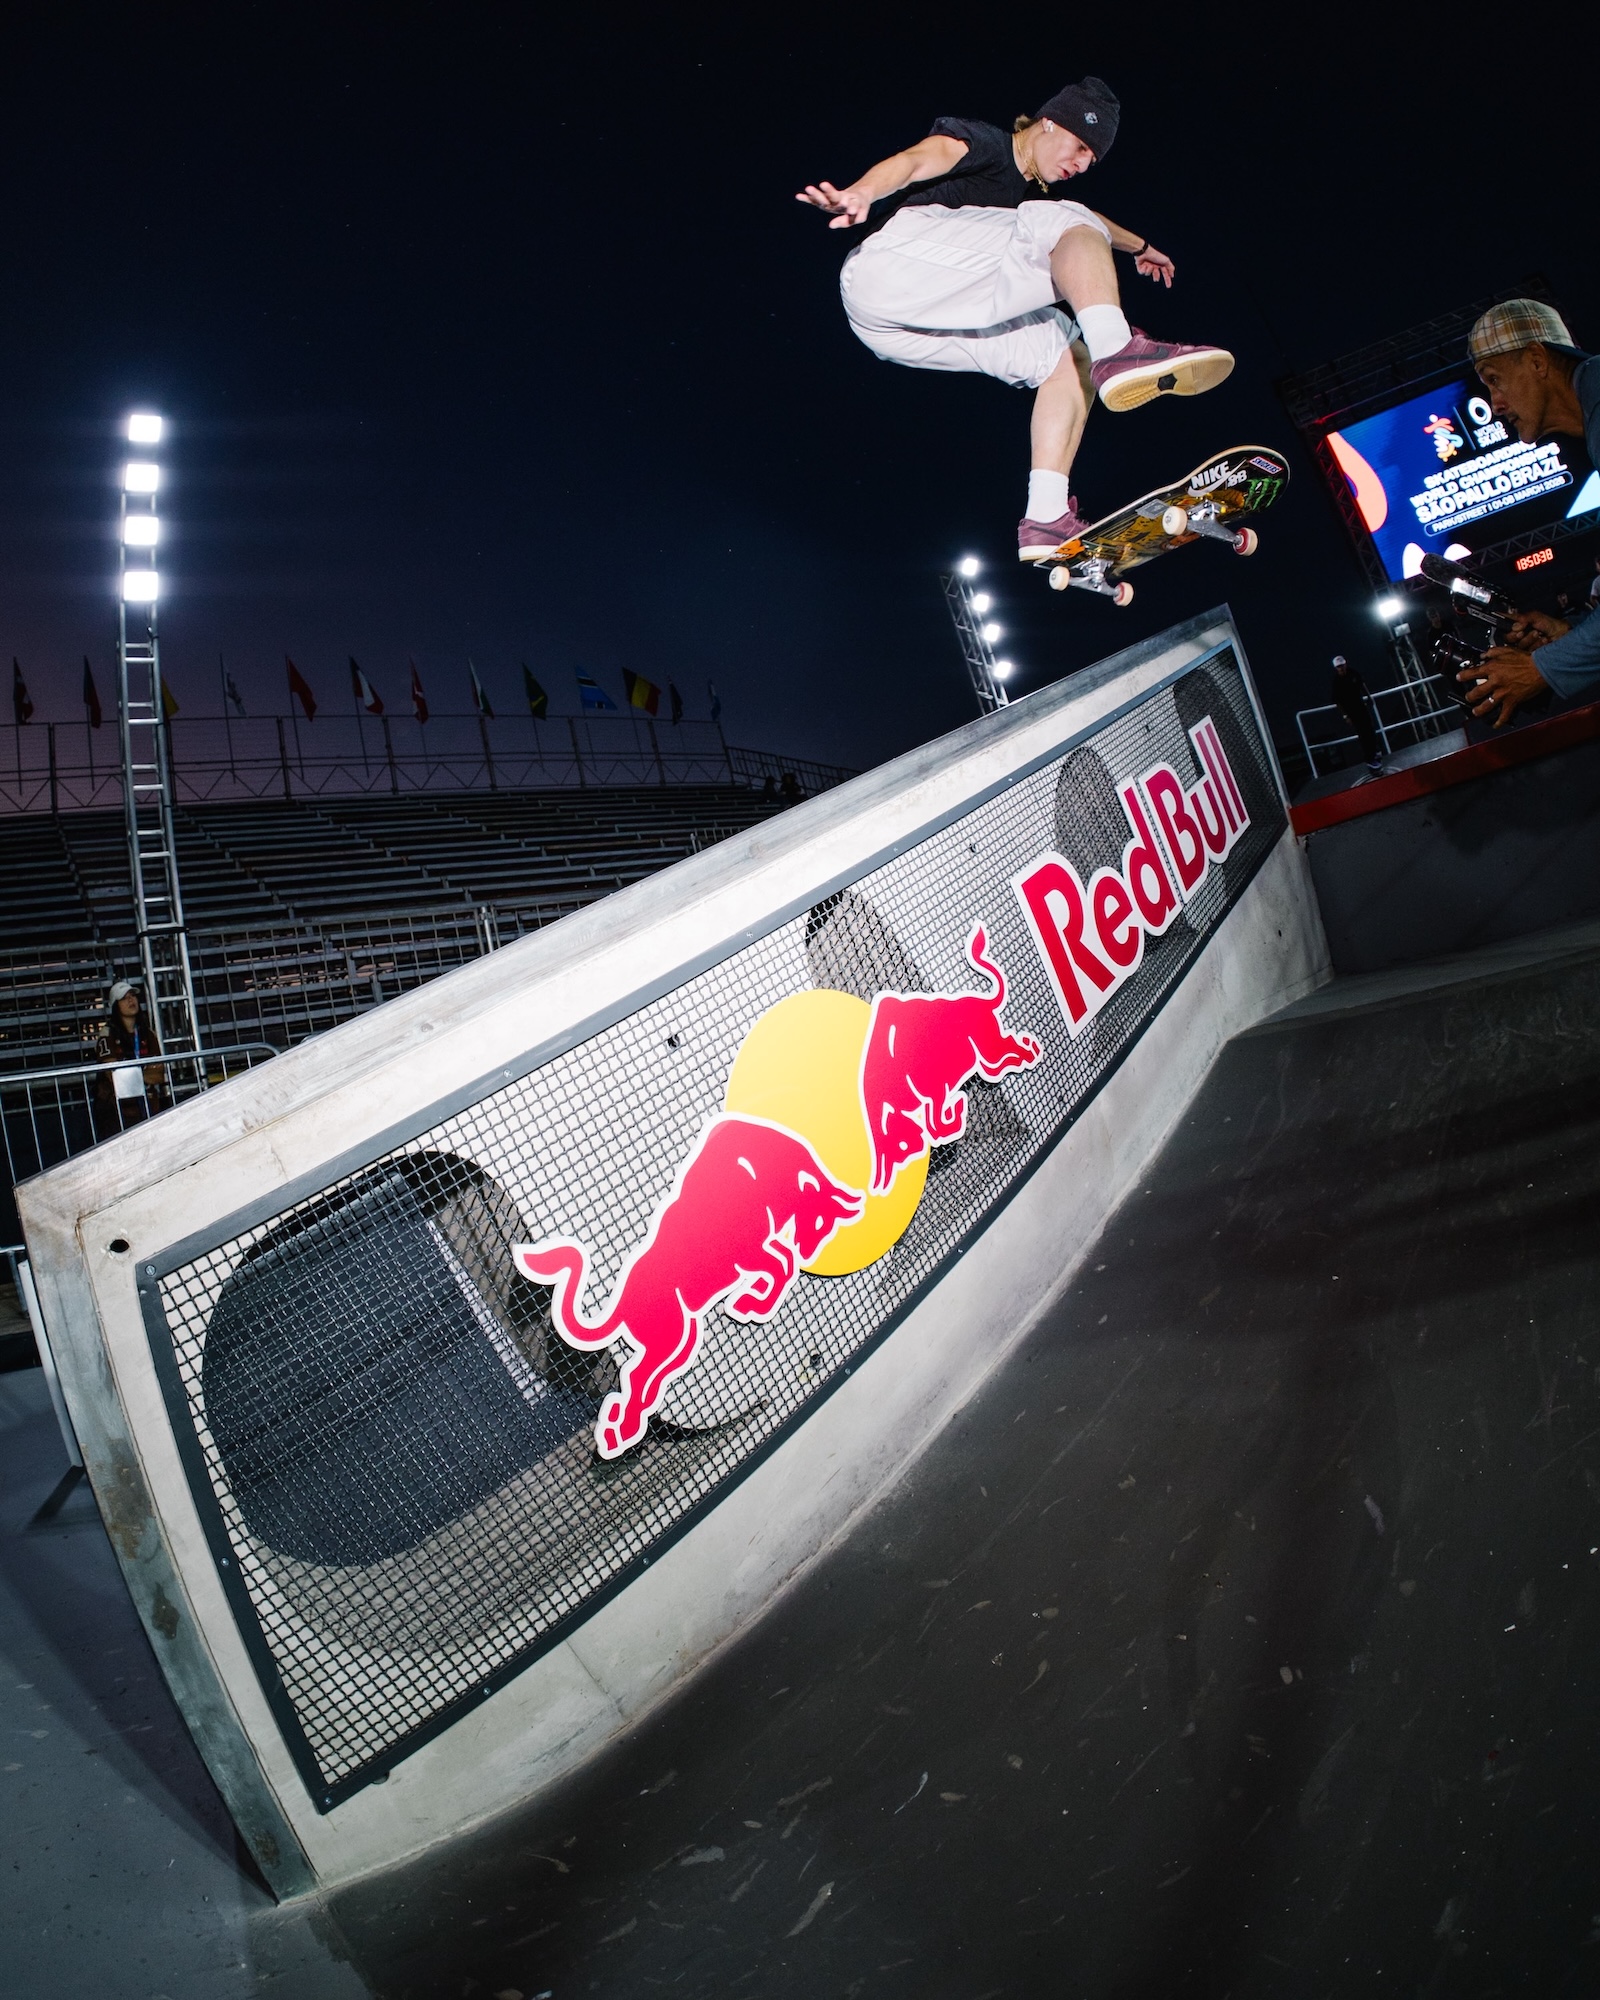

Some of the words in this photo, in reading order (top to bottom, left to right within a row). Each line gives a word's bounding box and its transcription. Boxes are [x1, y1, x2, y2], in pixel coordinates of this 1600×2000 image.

[1473, 421, 1503, 438] WORLD
[1478, 429, 1509, 447] SKATE
[1191, 460, 1230, 489] NIKE
[1410, 480, 1459, 507] WORLD
[1459, 442, 1560, 488] CHAMPIONSHIPS
[1416, 496, 1456, 524] SÃO
[1456, 475, 1512, 509] PAULO
[1509, 455, 1568, 487] BRAZIL
[1514, 484, 1545, 502] MARCH
